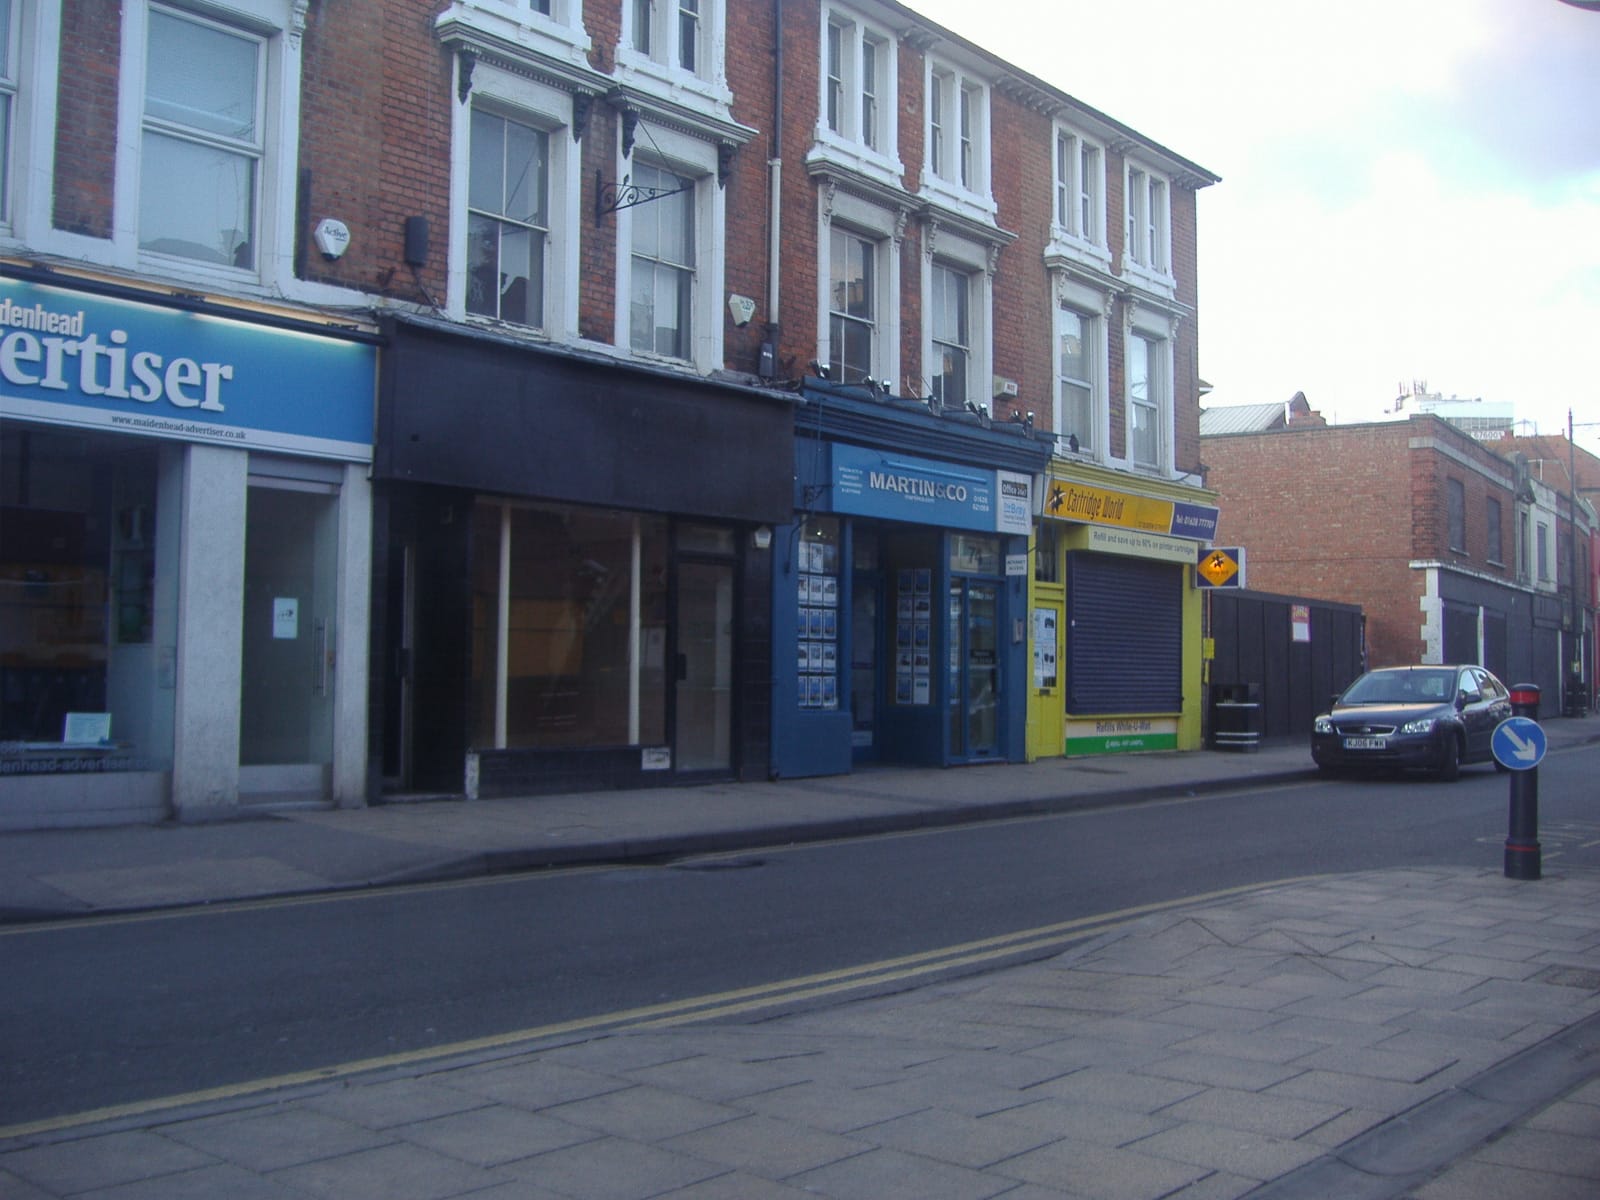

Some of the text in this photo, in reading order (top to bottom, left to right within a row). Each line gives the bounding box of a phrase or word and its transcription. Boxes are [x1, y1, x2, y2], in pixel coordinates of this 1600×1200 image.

[324, 226, 347, 239] Active
[0, 329, 233, 412] ertiser
[112, 415, 246, 439] www.maidenhead-advertiser.co.uk
[869, 471, 967, 502] MARTIN&CO
[1066, 487, 1125, 520] Cartridge World
[1108, 533, 1117, 542] and
[1118, 536, 1128, 544] save
[1129, 537, 1136, 546] up
